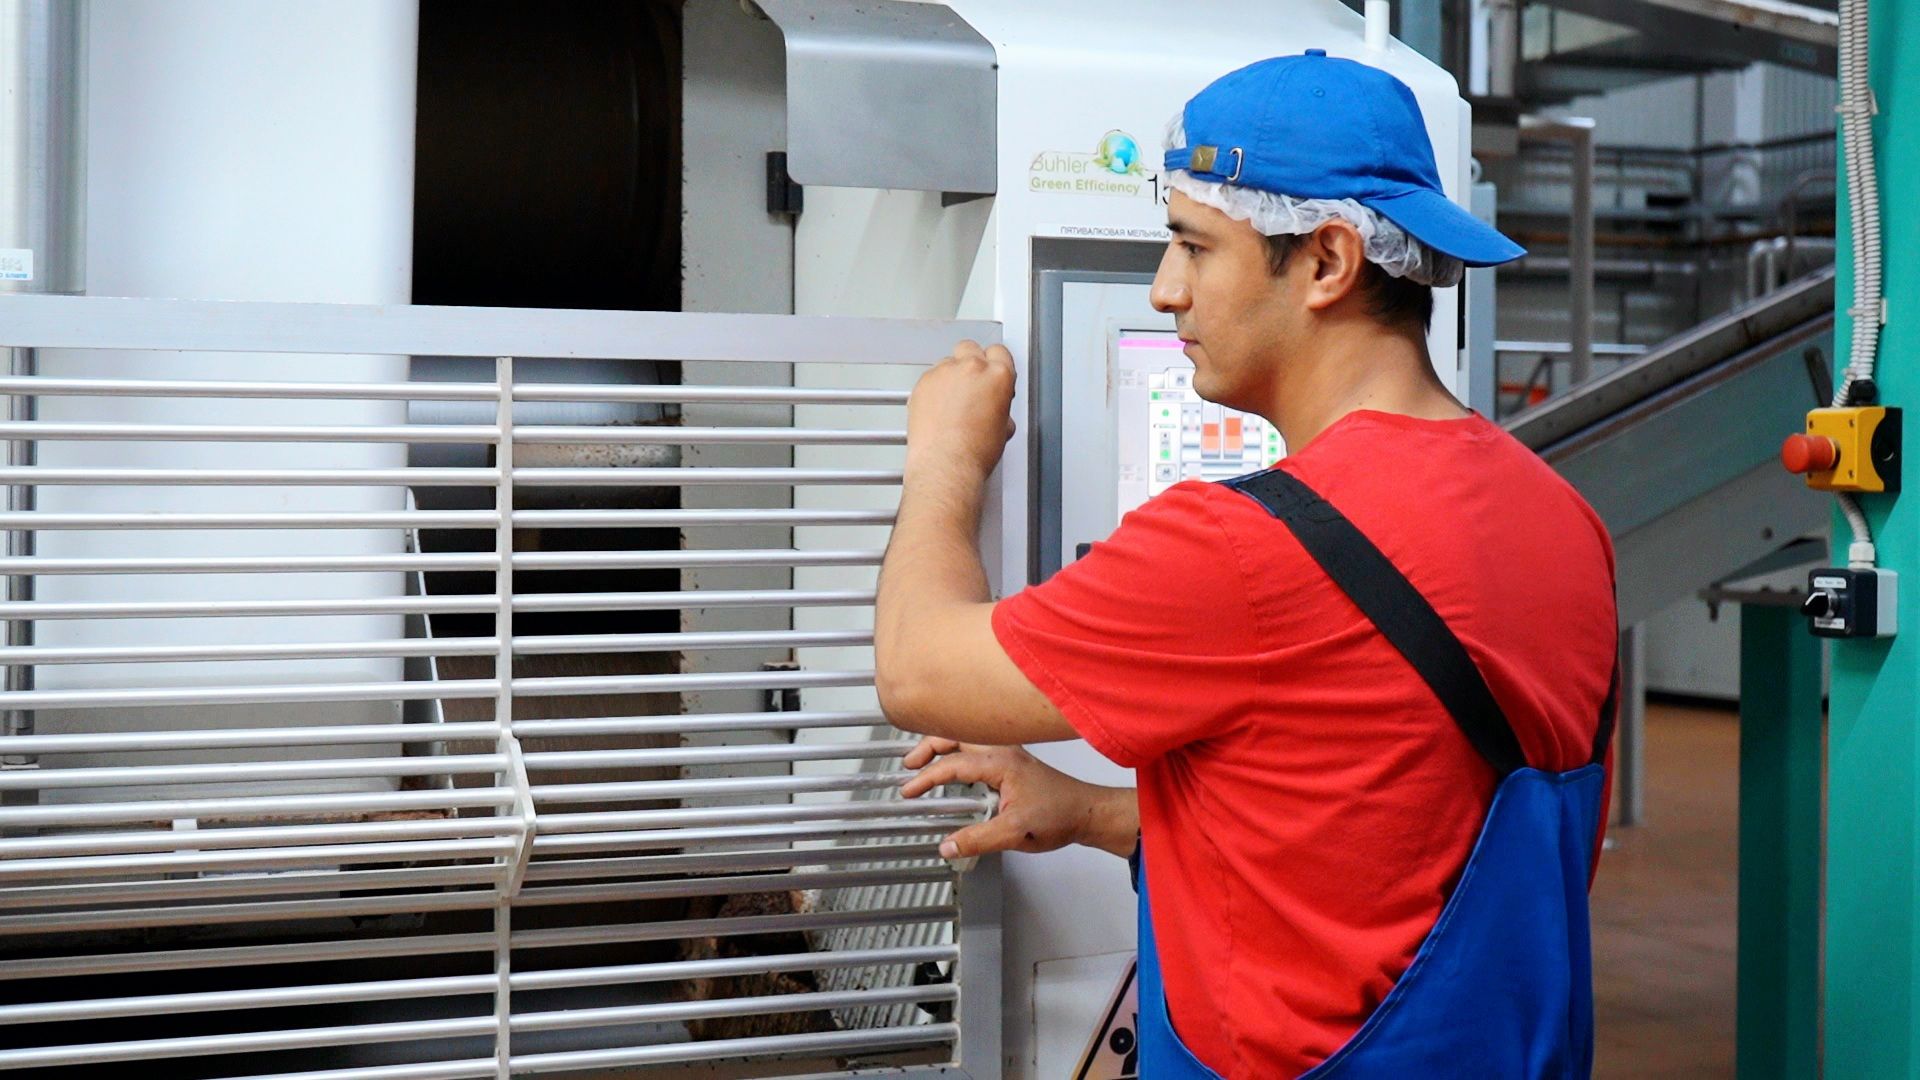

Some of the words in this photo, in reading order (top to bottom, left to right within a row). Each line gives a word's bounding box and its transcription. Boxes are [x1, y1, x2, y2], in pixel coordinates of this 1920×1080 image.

[1031, 177, 1071, 190] Green
[1076, 179, 1140, 196] Efficiency
[1060, 226, 1126, 236] ПЯТИВАЛКОВАЯ
[1127, 229, 1170, 238] МЕЛЬНИЦА
